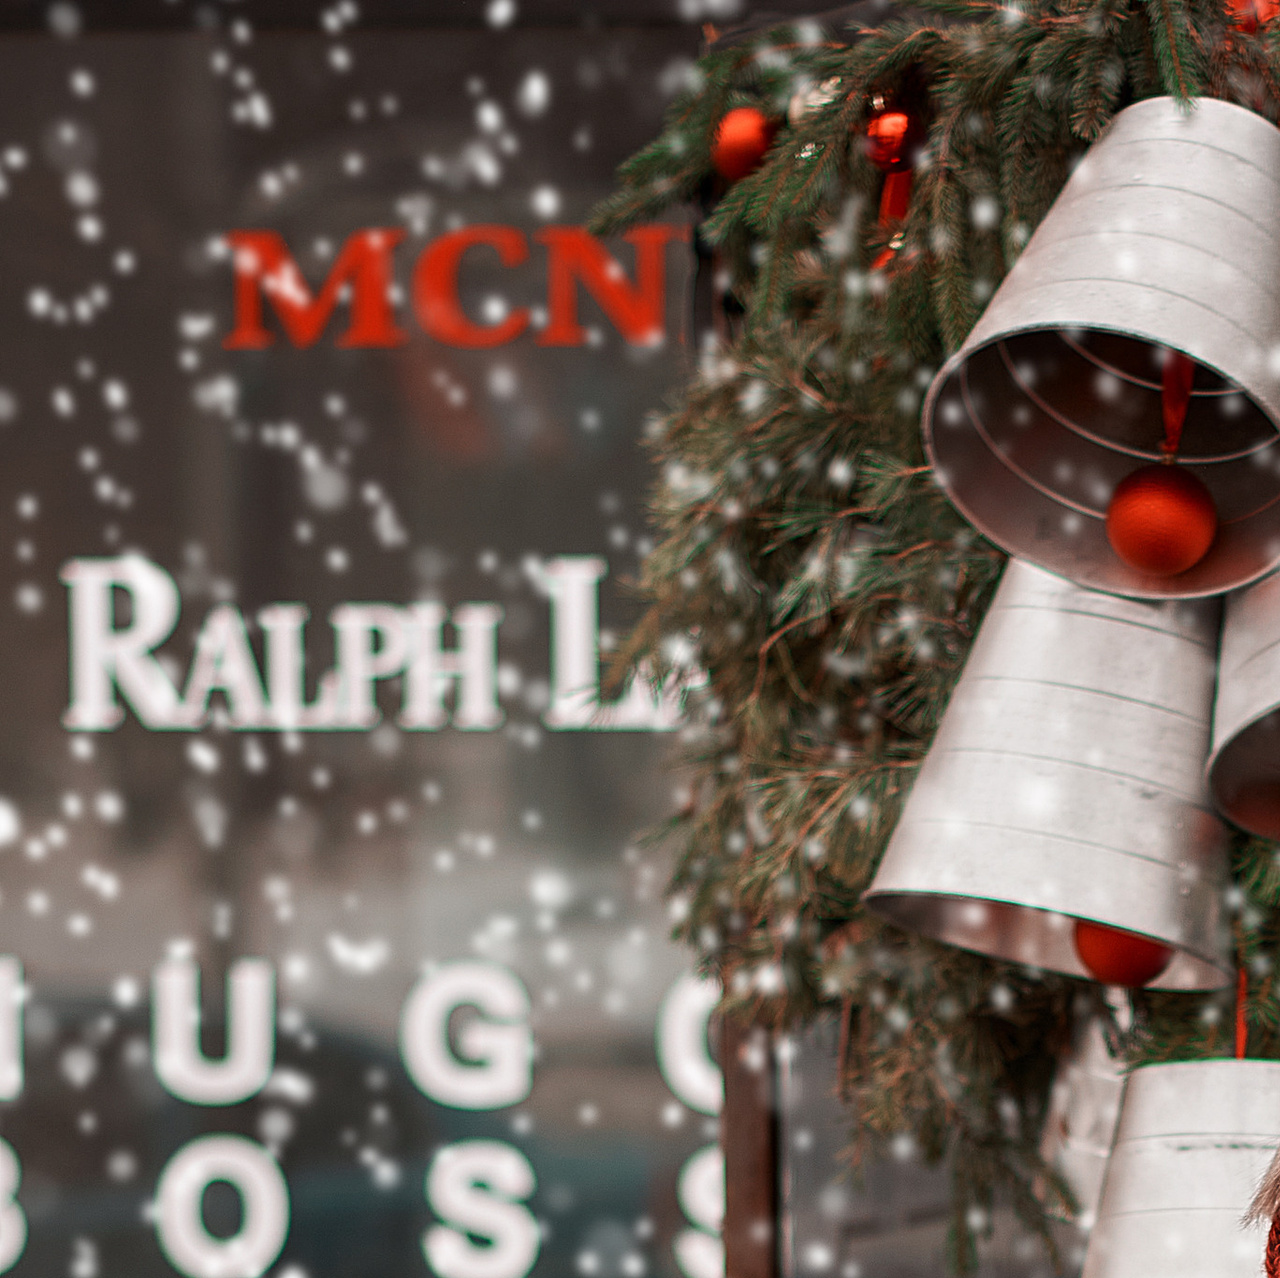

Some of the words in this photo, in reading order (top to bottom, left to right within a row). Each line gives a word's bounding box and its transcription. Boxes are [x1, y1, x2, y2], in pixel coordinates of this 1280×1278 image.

[62, 551, 505, 732] RALPH
[541, 553, 711, 732] L
[0, 955, 725, 1118] UG
